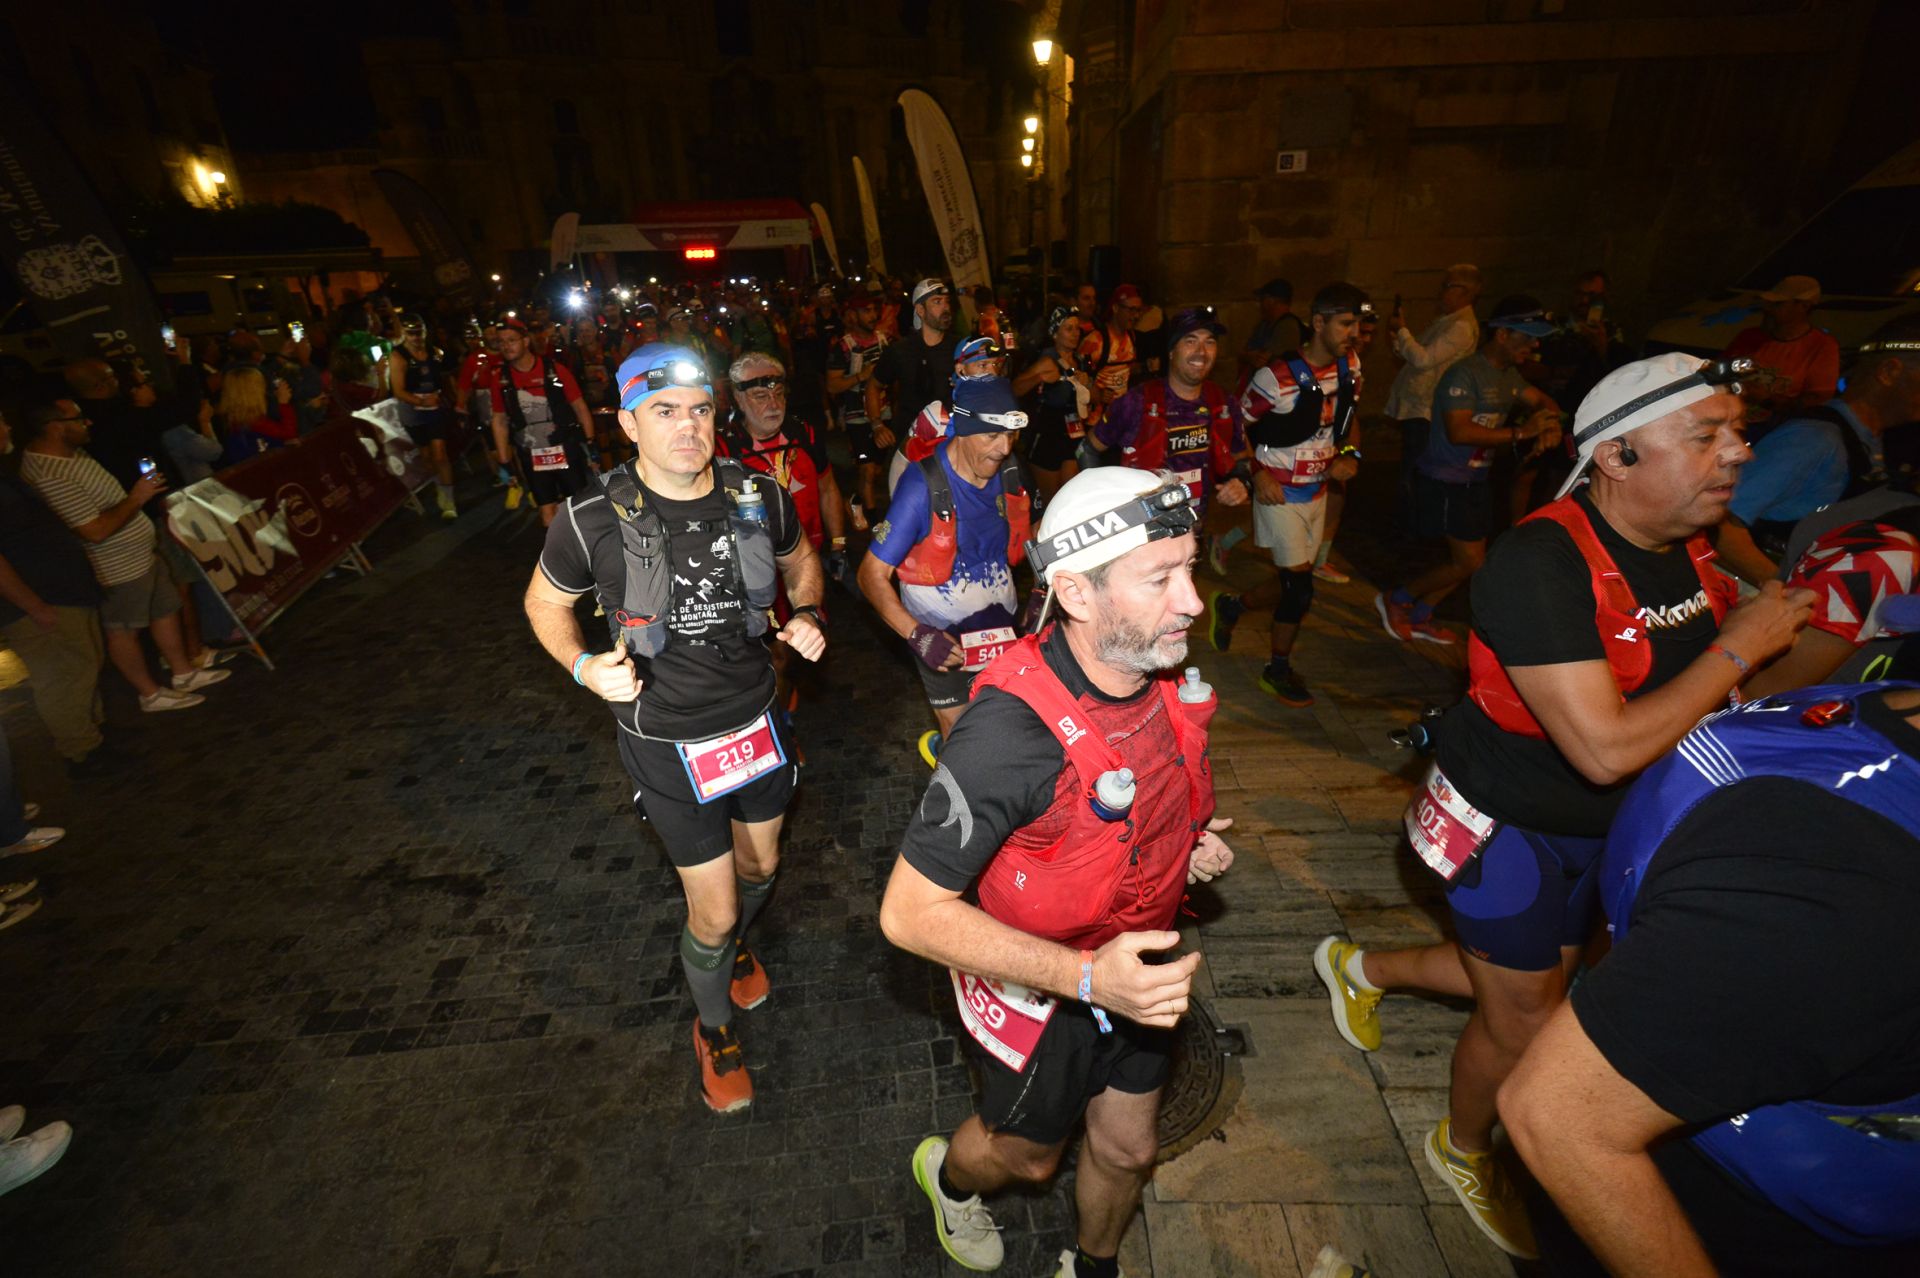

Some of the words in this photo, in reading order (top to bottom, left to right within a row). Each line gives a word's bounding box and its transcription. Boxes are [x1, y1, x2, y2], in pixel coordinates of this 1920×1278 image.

[1168, 433, 1208, 451] Trigo
[1053, 510, 1129, 557] SILVA
[679, 605, 690, 614] DE
[693, 599, 741, 612] RESISTENCIA
[978, 644, 1004, 664] 541
[715, 740, 755, 772] 219
[1014, 870, 1027, 885] 12
